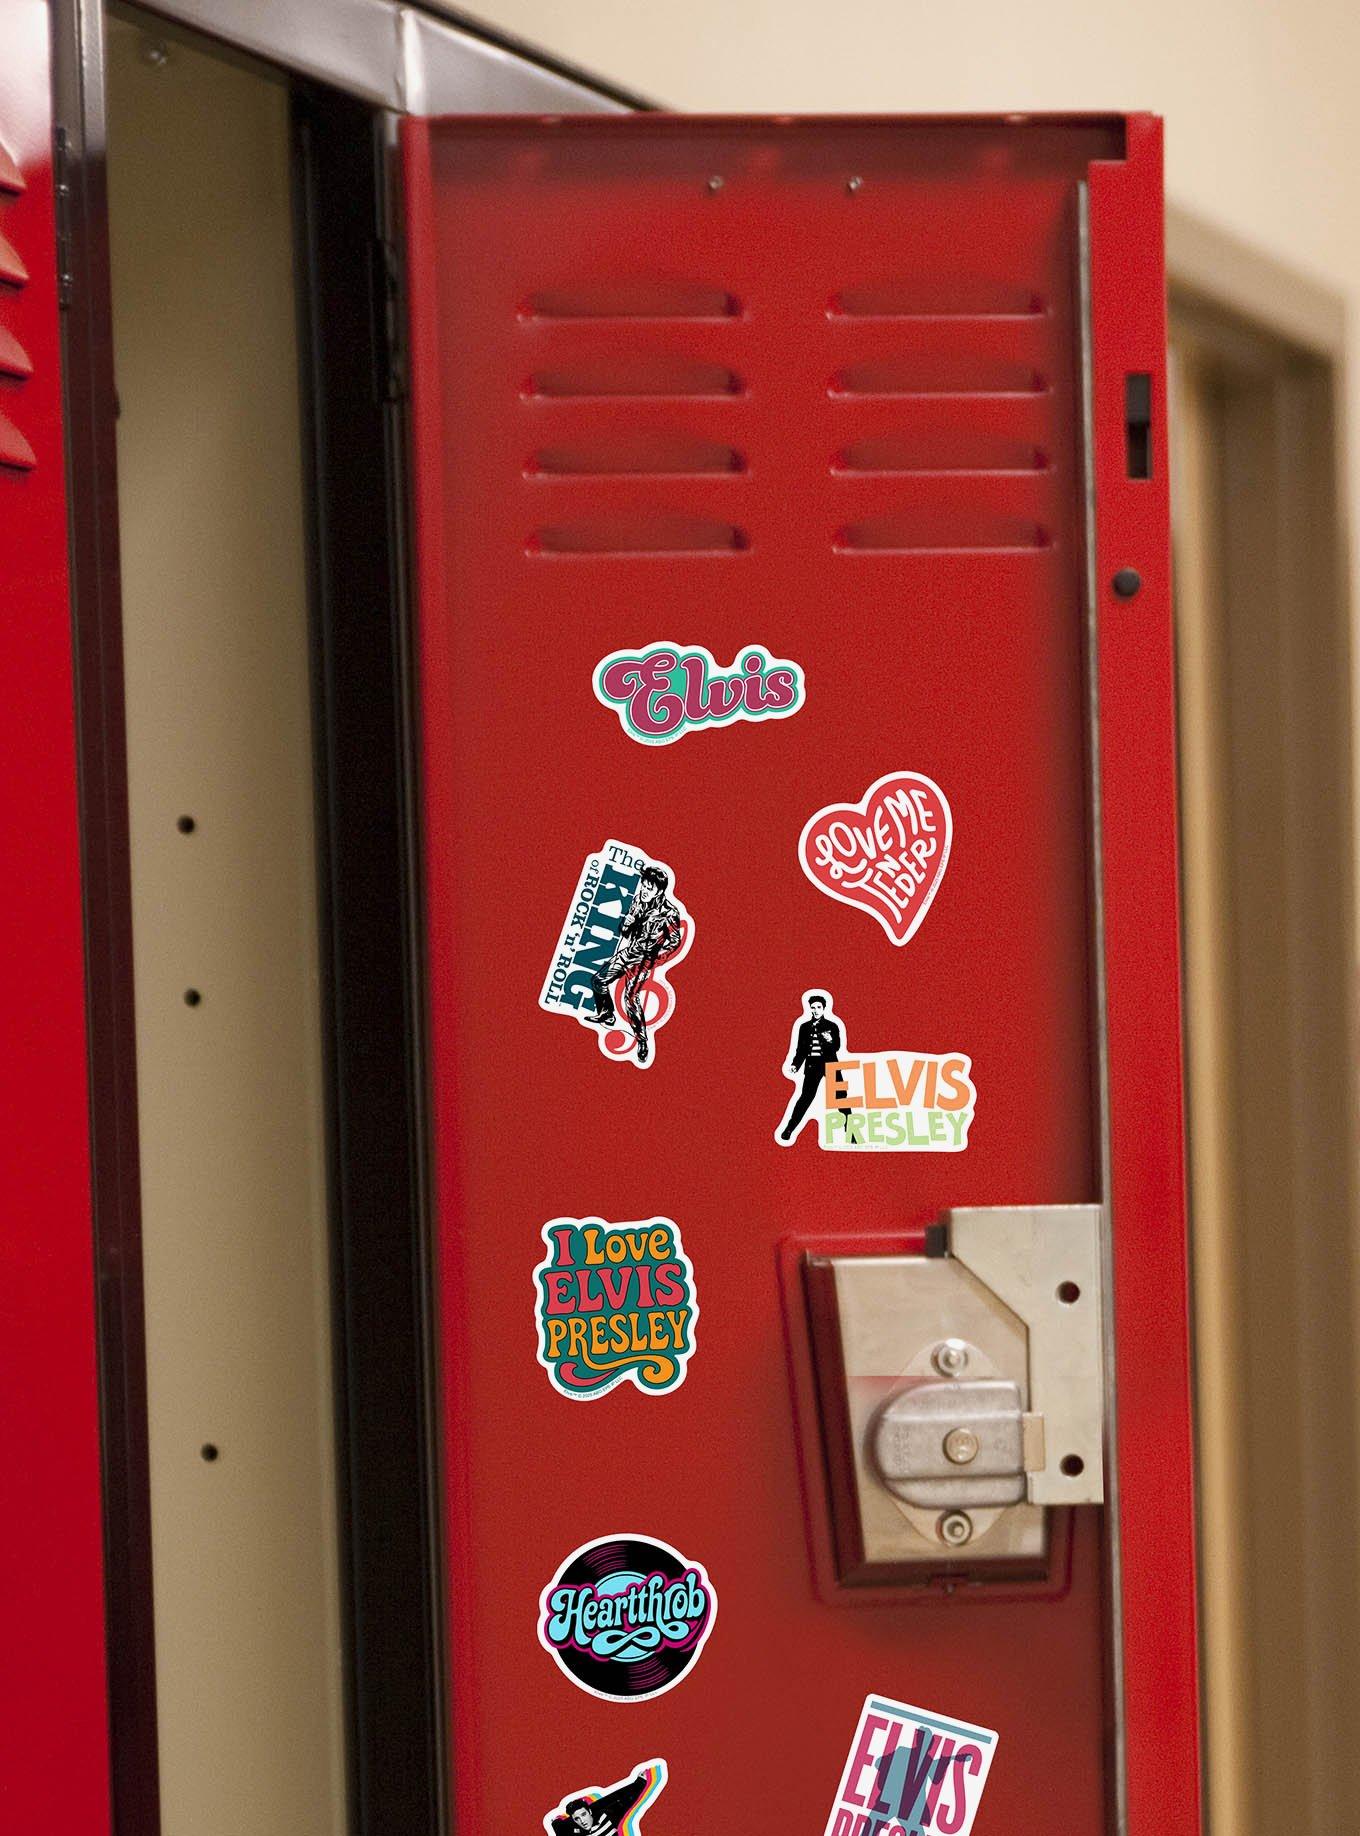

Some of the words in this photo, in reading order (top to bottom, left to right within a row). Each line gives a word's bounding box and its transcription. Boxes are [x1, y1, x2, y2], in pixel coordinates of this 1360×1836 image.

[603, 652, 795, 734] Elvis
[608, 846, 646, 871] The
[815, 805, 894, 880] LOVE
[884, 789, 937, 849] ME
[591, 859, 600, 874] of
[571, 876, 600, 935] ROCK
[560, 863, 641, 1012] KING
[545, 955, 574, 1004] ROLL
[825, 1059, 970, 1111] ELVIS
[826, 1112, 969, 1145] PRESLEY
[553, 1229, 576, 1266] I
[583, 1228, 672, 1265] Love
[544, 1263, 686, 1315] ELVIS
[547, 1310, 689, 1368] PRESLEY
[548, 1572, 706, 1647] Heartthrob
[841, 1714, 983, 1835] ELVIS
